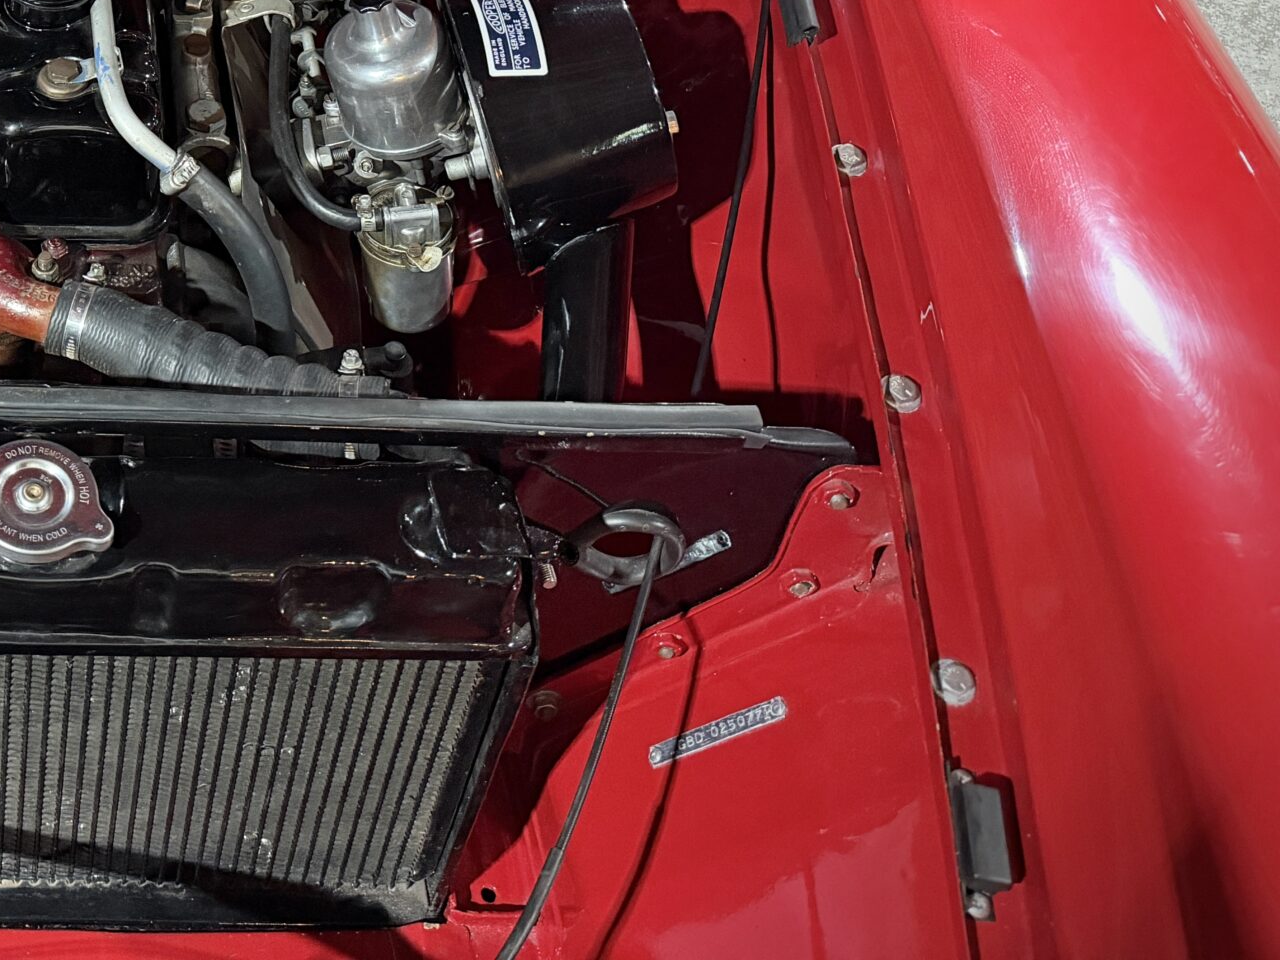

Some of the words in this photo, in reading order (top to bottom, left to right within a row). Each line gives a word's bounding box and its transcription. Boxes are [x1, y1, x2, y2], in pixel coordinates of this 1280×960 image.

[503, 12, 511, 20] OF
[507, 24, 519, 50] SERVICE
[513, 19, 526, 46] VEHICLE
[492, 48, 500, 65] MADE
[496, 38, 507, 66] ENGLAND
[514, 54, 522, 69] FOR
[522, 57, 530, 69] TO
[5, 450, 17, 459] DO
[19, 445, 37, 455] NOT
[38, 446, 70, 465] REMOVE
[69, 463, 86, 485] WHEN
[79, 485, 90, 505] HOT
[18, 533, 44, 542] WHEN
[45, 527, 68, 541] COLD
